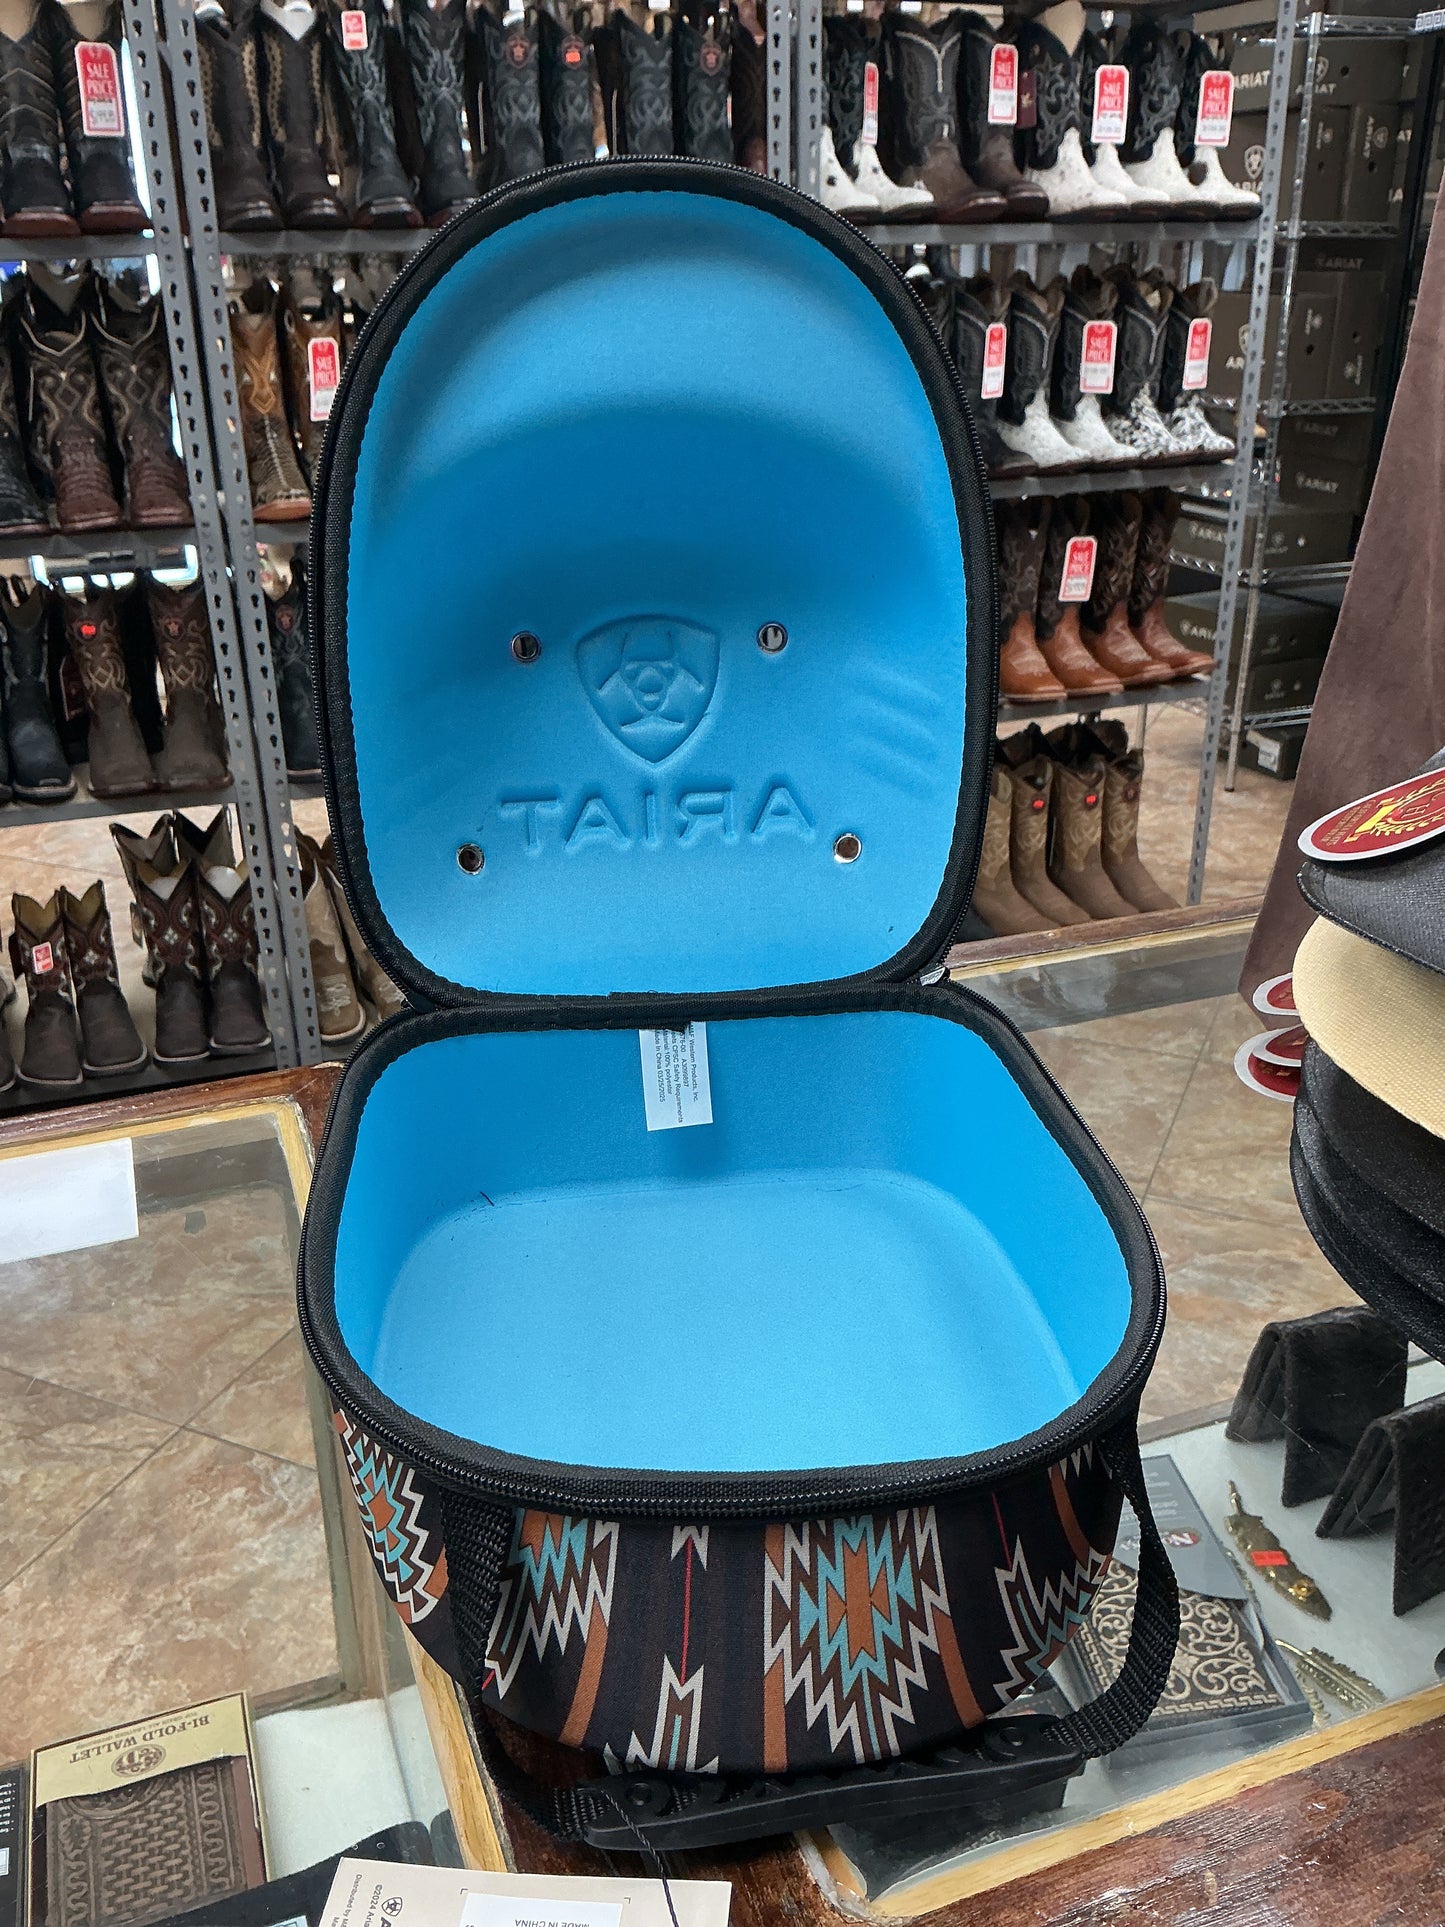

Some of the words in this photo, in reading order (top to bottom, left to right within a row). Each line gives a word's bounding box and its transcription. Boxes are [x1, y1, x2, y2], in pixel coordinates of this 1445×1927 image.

[86, 62, 110, 79] SALE
[87, 79, 114, 97] PRICE
[1103, 81, 1121, 95] SALE
[1207, 87, 1226, 100] SALE
[1101, 96, 1121, 110] PRICE
[1205, 101, 1226, 115] PRICE
[675, 1084, 683, 1123] Requirements
[143, 1714, 210, 1742] BI-FOLD
[69, 1736, 138, 1764] WALLET
[346, 1873, 363, 1909] Distributed
[343, 1908, 351, 1918] by
[515, 1919, 546, 1927] CHINA
